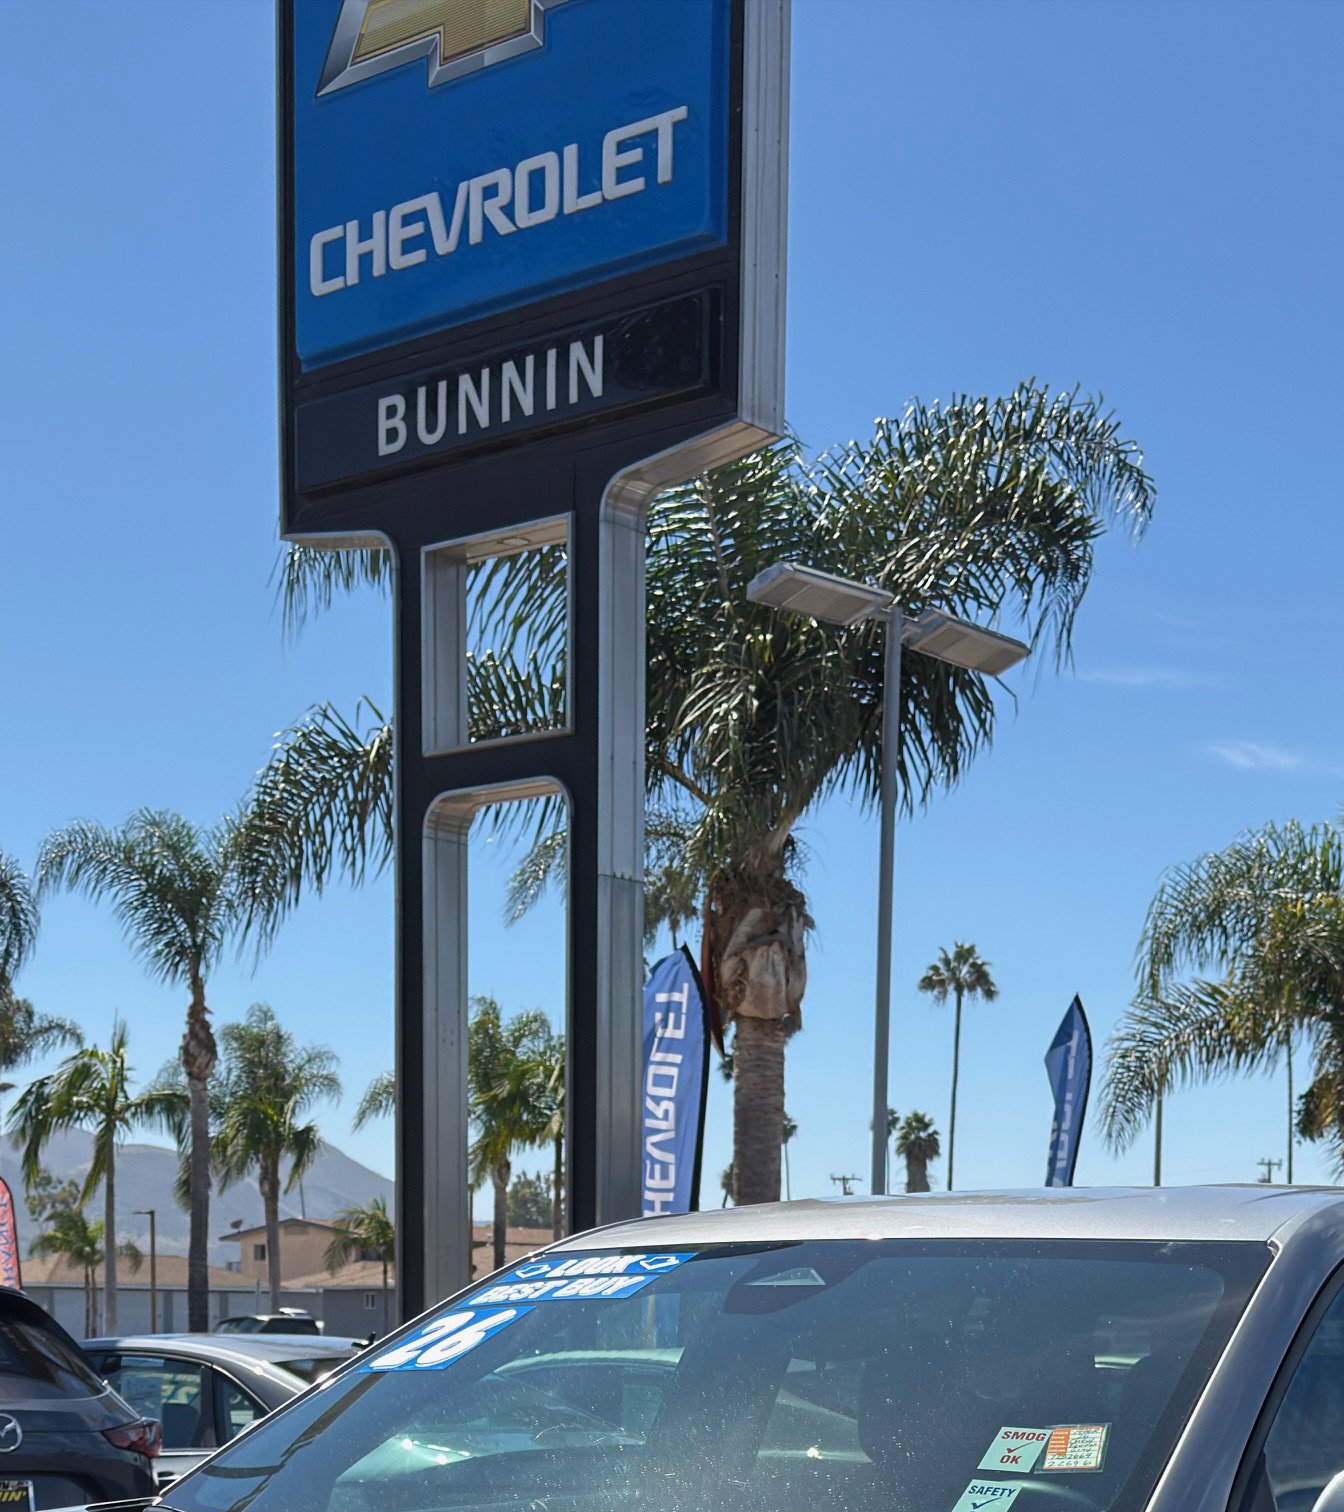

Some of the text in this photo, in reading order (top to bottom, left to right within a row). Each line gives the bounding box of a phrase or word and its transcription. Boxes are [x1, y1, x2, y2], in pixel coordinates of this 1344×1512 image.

[310, 106, 688, 296] CHEVROLET
[378, 335, 604, 457] BUNNIN
[545, 1254, 647, 1277] LOOK
[469, 1275, 647, 1305] BEST BUY
[368, 1309, 517, 1369] 26
[1001, 1430, 1047, 1442] SMOG
[999, 1455, 1023, 1464] OK
[968, 1485, 1017, 1498] SAFETY
